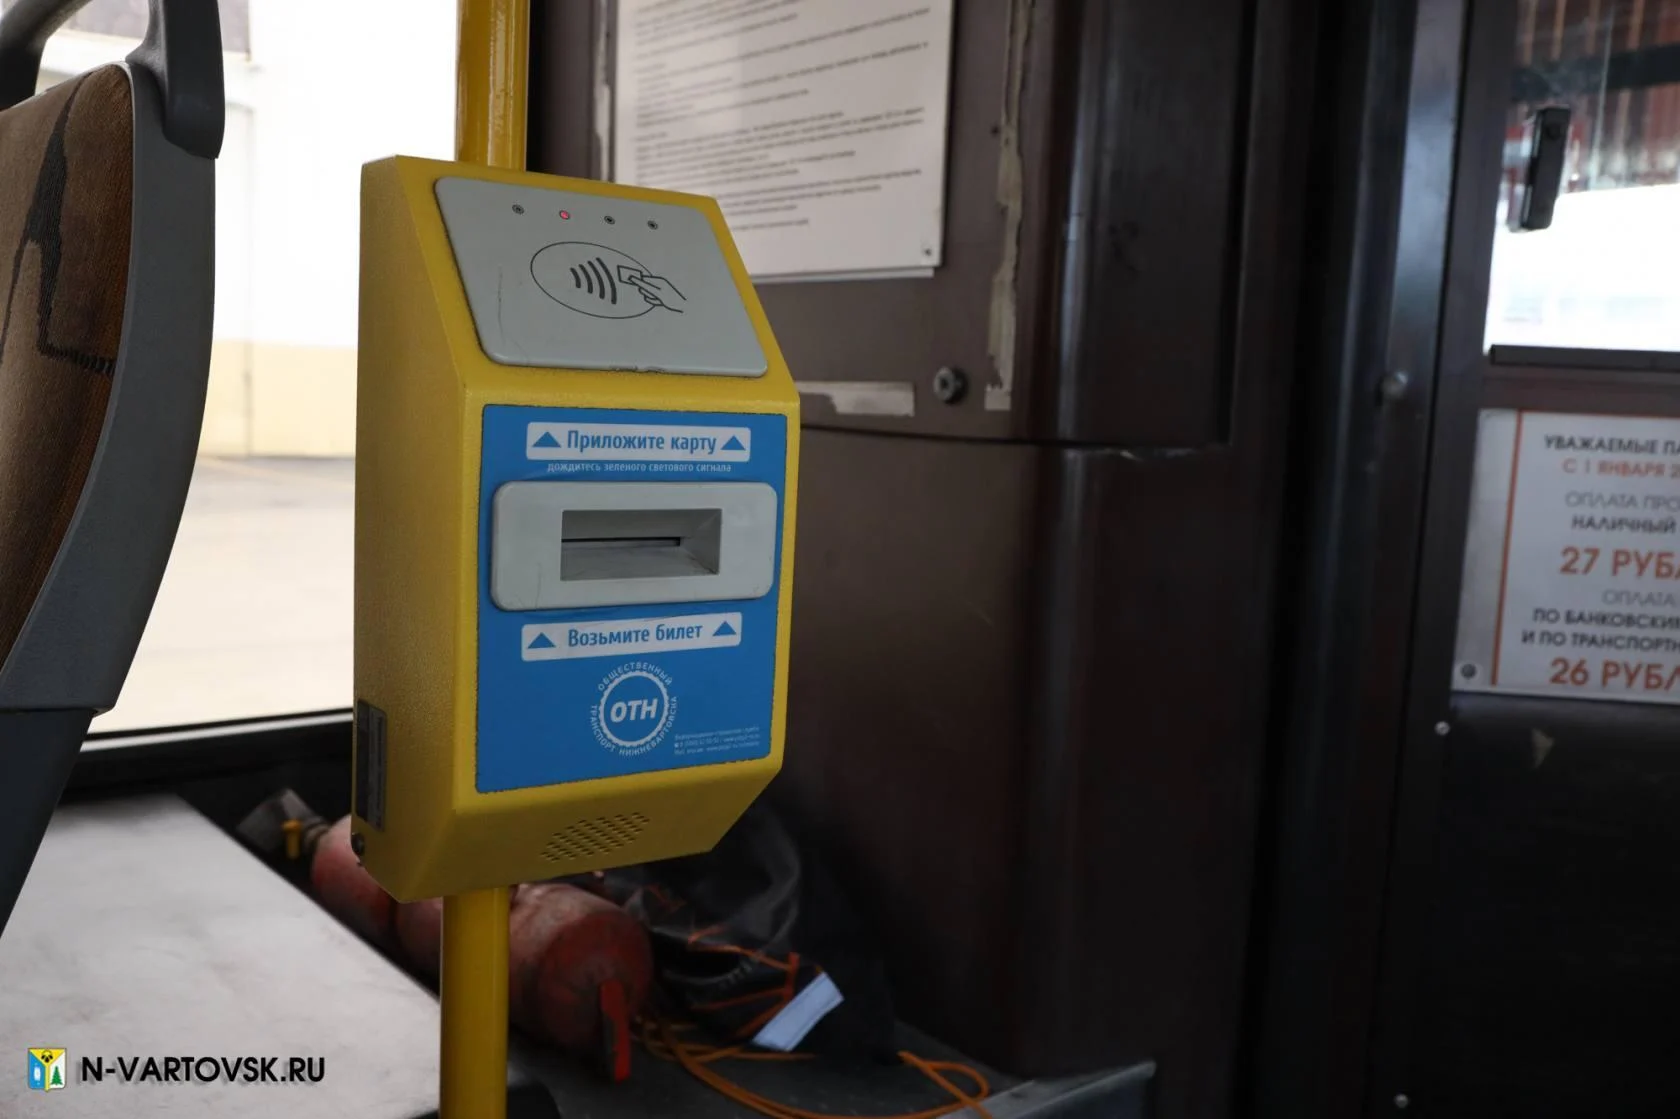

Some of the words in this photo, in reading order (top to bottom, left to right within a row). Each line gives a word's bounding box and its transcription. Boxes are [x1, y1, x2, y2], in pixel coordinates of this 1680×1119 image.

[567, 429, 665, 452] Приложите
[671, 436, 717, 454] карту
[1544, 435, 1659, 454] УВАЖАЕМЫЕ
[547, 462, 601, 473] дождитесь
[603, 464, 647, 473] зеленого
[649, 464, 694, 473] светового
[696, 465, 732, 473] сигнала
[1562, 457, 1576, 474] С
[1597, 460, 1665, 478] ЯНВАРЯ
[1565, 490, 1638, 509] ОПЛАТА
[1572, 514, 1677, 534] НАЛИЧНЫЙ
[1560, 546, 1600, 575] 27
[1612, 549, 1680, 580] РУБ
[1602, 589, 1677, 608] ОПЛАТА
[1533, 608, 1561, 624] ПО
[1565, 609, 1680, 630] БАНКОВСКИ
[568, 628, 650, 647] Возьмите
[655, 624, 703, 640] билет
[1521, 630, 1535, 645] И
[1539, 630, 1567, 647] ПО
[598, 662, 673, 691] ОБЩЕСТВЕННЫЙ
[1550, 657, 1589, 686] 26
[610, 698, 658, 723] ОТН
[589, 705, 616, 753] ТРАНСПОРТ
[619, 696, 677, 757] НИЖНЕВАРТОВСКА
